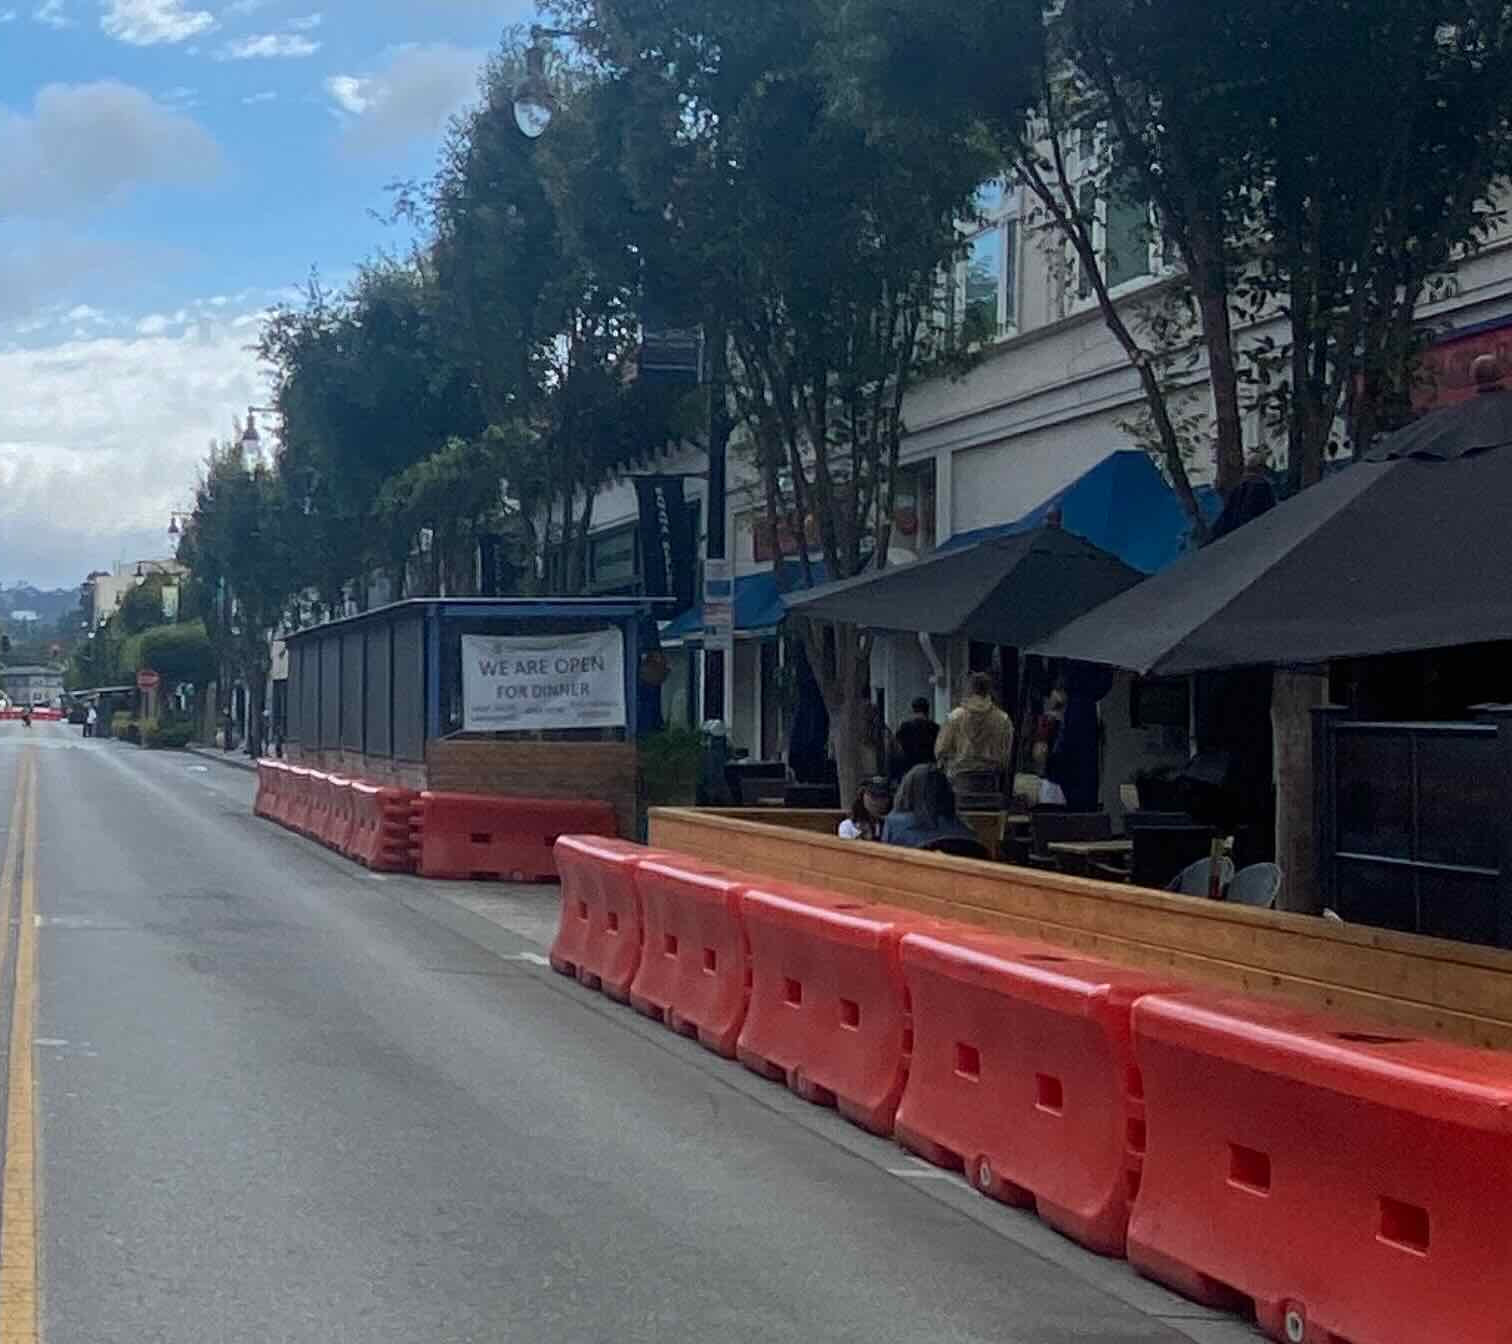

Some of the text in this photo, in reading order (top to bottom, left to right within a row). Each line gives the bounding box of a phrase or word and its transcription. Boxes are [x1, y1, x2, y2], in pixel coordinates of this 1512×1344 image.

[478, 656, 605, 677] WE ARE OPEN
[496, 682, 590, 699] FOR DINNER
